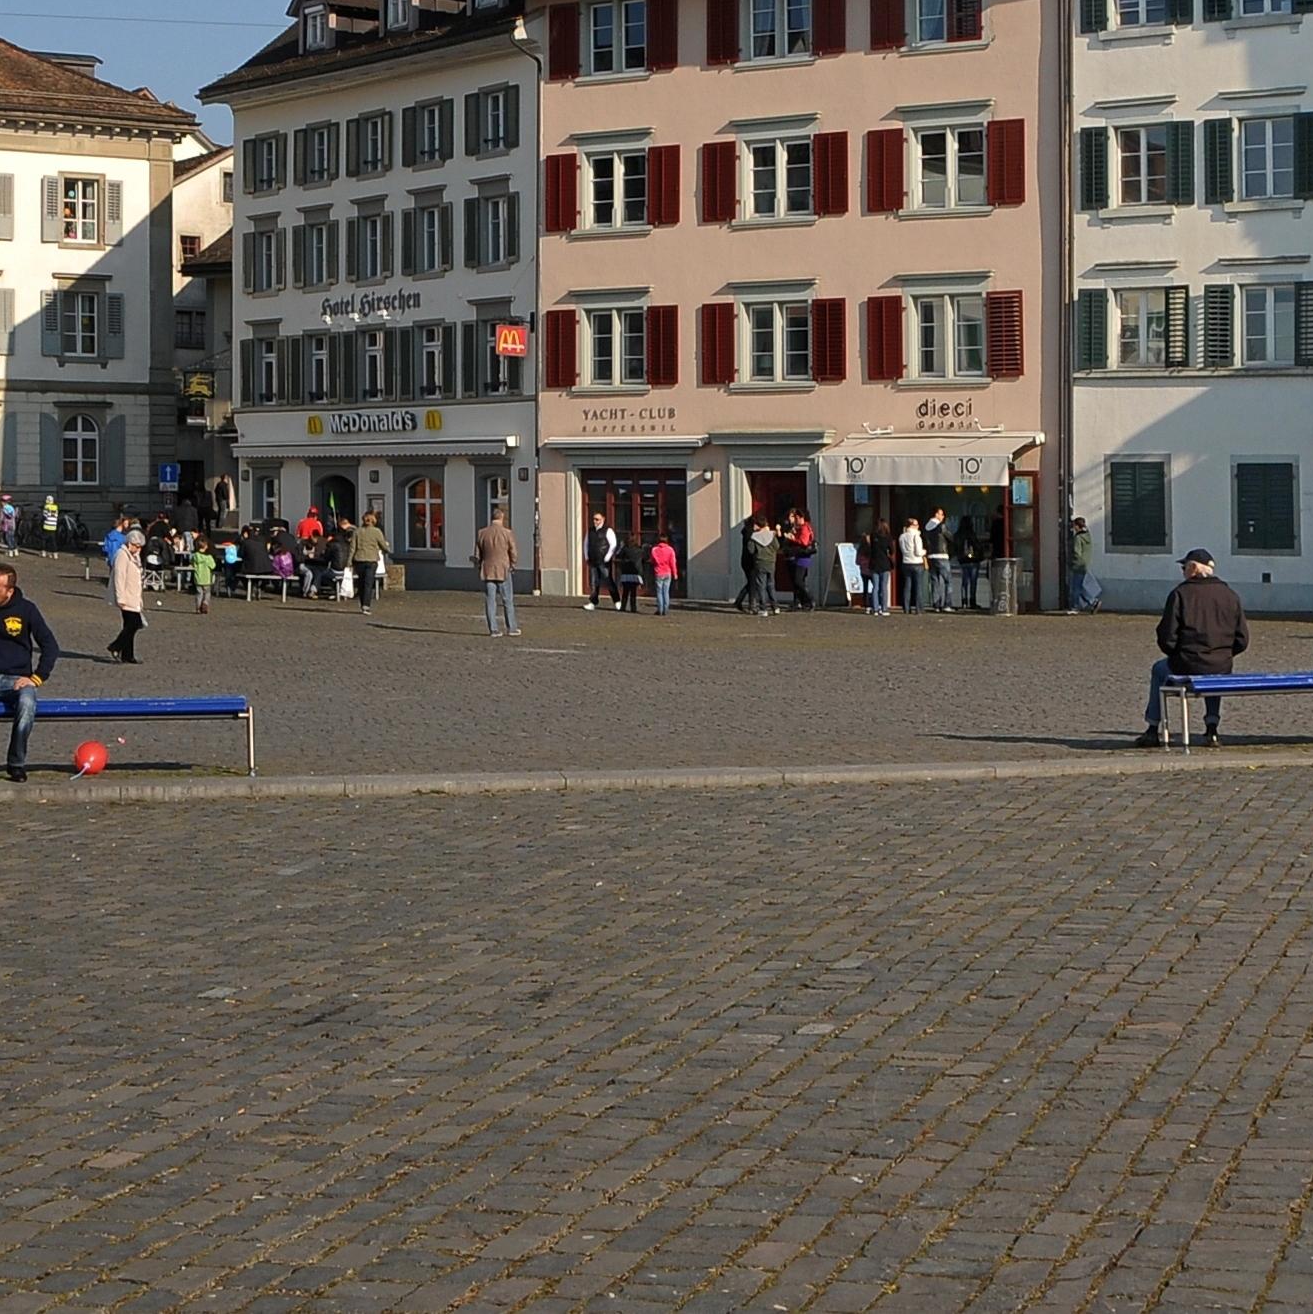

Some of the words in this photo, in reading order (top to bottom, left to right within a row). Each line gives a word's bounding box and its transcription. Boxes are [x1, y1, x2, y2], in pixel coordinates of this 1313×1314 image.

[321, 294, 355, 317] Hotel
[359, 288, 421, 317] Hirschen
[917, 398, 972, 417] dieci
[329, 409, 416, 433] McDonald's
